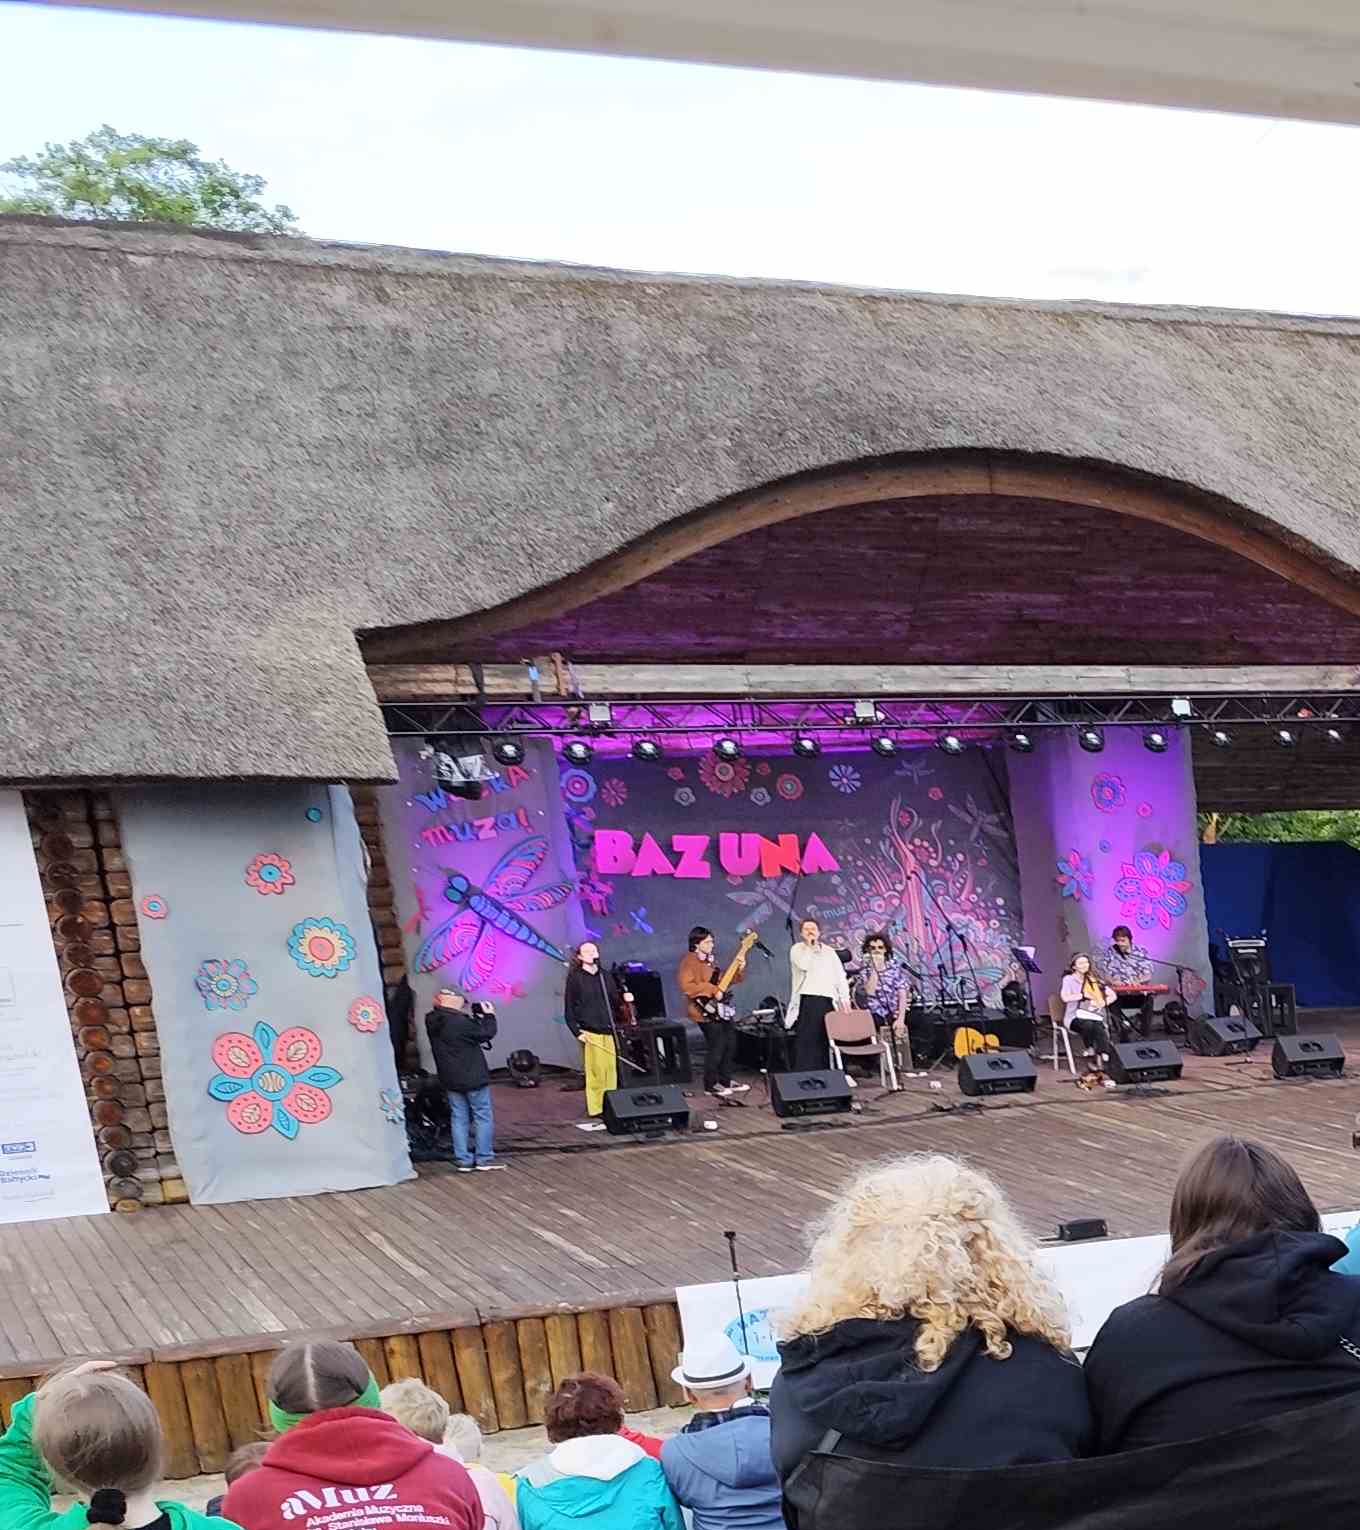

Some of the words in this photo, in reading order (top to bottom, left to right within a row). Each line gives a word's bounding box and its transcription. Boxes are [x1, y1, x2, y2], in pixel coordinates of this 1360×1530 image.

[594, 829, 841, 879] BAZUNA
[280, 1483, 398, 1520] aMuz
[306, 1507, 364, 1528] Akademia
[365, 1504, 424, 1516] Muzyczna
